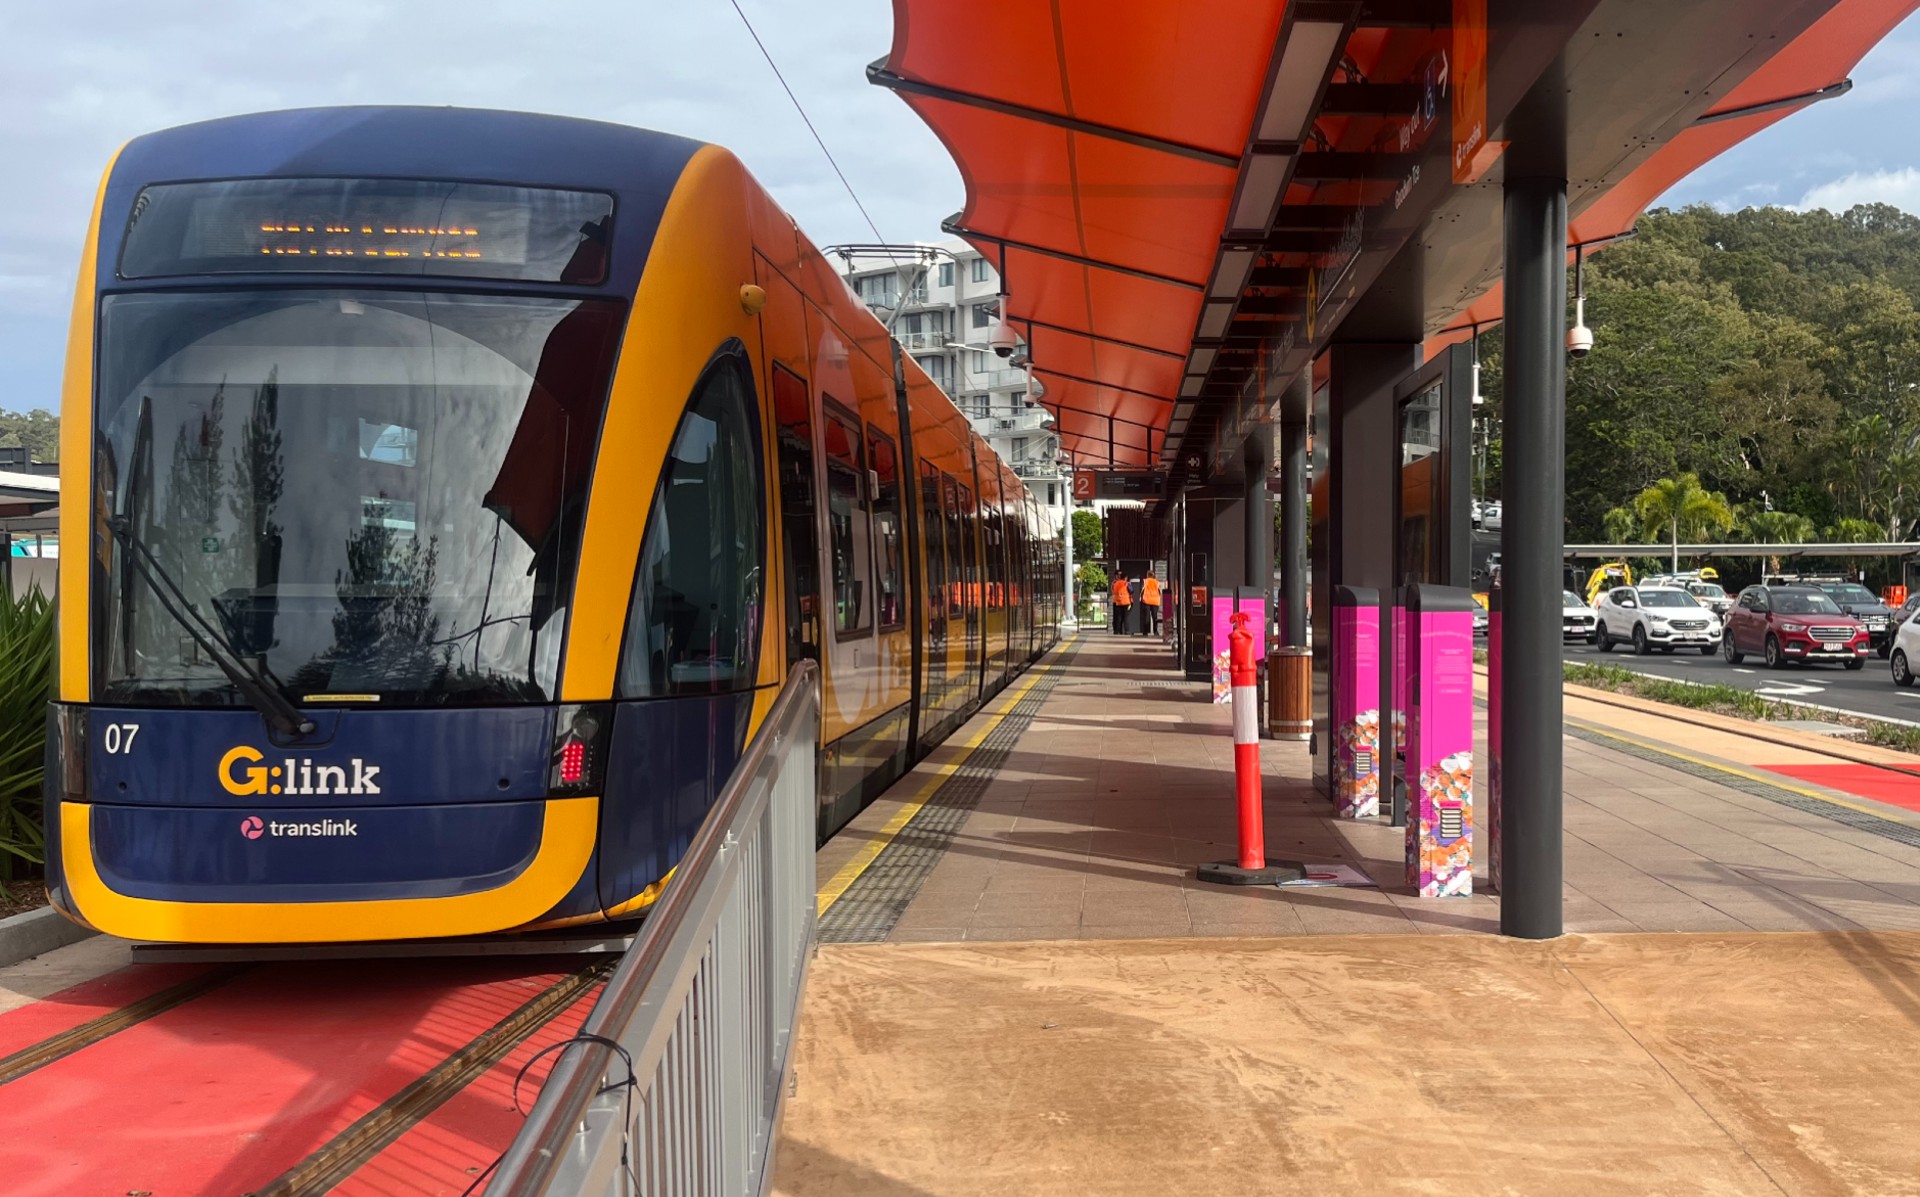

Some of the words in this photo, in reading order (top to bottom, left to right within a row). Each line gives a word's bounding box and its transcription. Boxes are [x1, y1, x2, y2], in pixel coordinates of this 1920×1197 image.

[1411, 101, 1420, 135] out
[1077, 478, 1089, 495] 2
[104, 723, 140, 754] 07
[218, 745, 381, 796] G:link
[269, 819, 358, 837] translink
